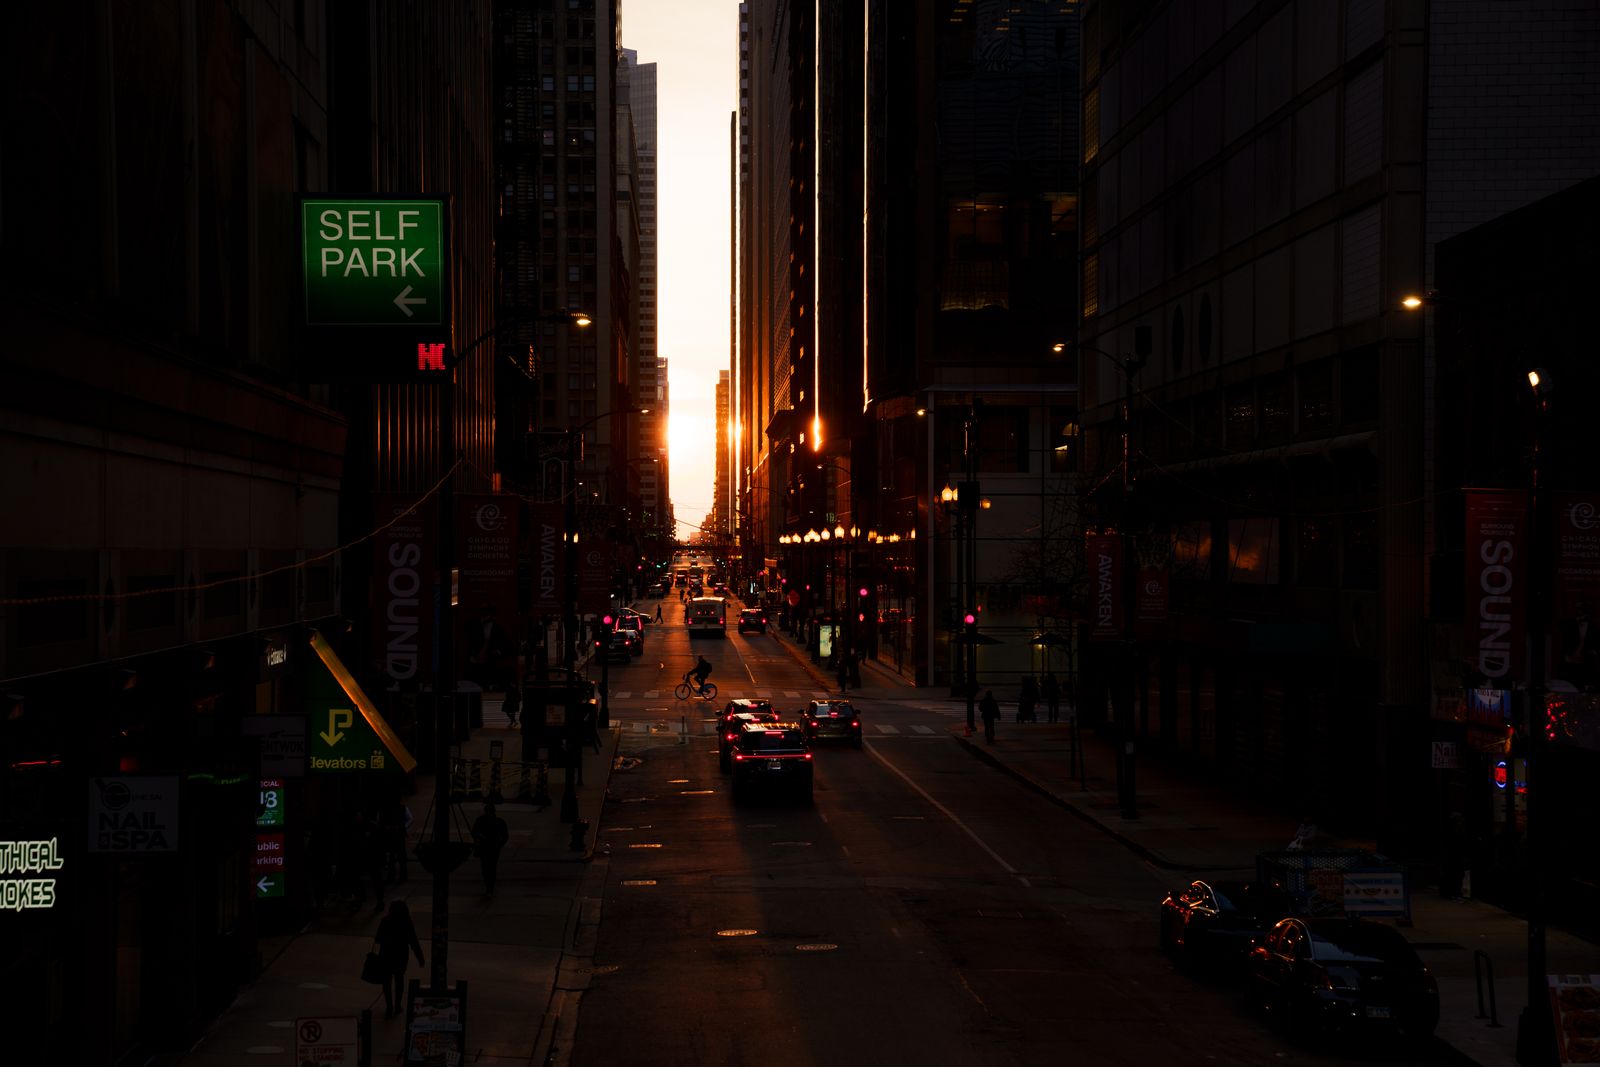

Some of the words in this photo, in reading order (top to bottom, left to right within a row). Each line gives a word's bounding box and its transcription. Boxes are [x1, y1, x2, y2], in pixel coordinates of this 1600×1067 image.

[319, 210, 421, 241] SELF
[321, 247, 426, 277] PARK
[540, 523, 556, 599] AWAKEN
[386, 542, 421, 680] SOUND
[1098, 553, 1113, 627] AWAKEN
[1479, 538, 1514, 678] SOUND
[99, 812, 166, 831] NAIL
[112, 830, 169, 849] SPA
